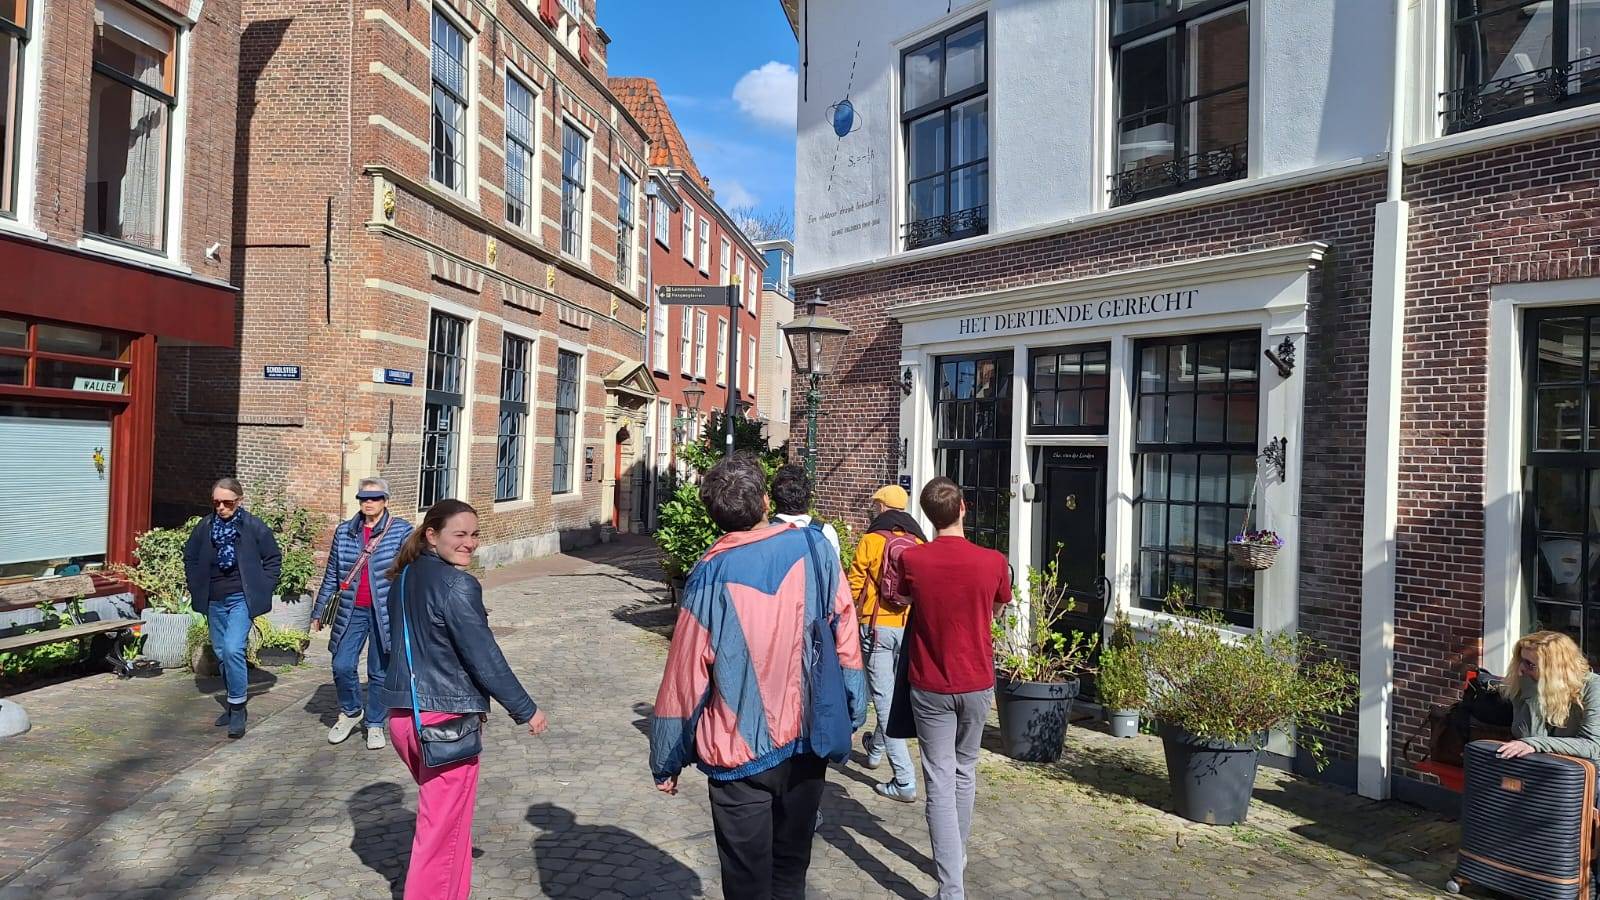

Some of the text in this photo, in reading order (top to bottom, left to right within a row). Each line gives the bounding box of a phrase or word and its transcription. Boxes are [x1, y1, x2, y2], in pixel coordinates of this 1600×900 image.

[959, 289, 1199, 335] HET DERTIENDE GERECHT
[84, 381, 116, 391] WALLER
